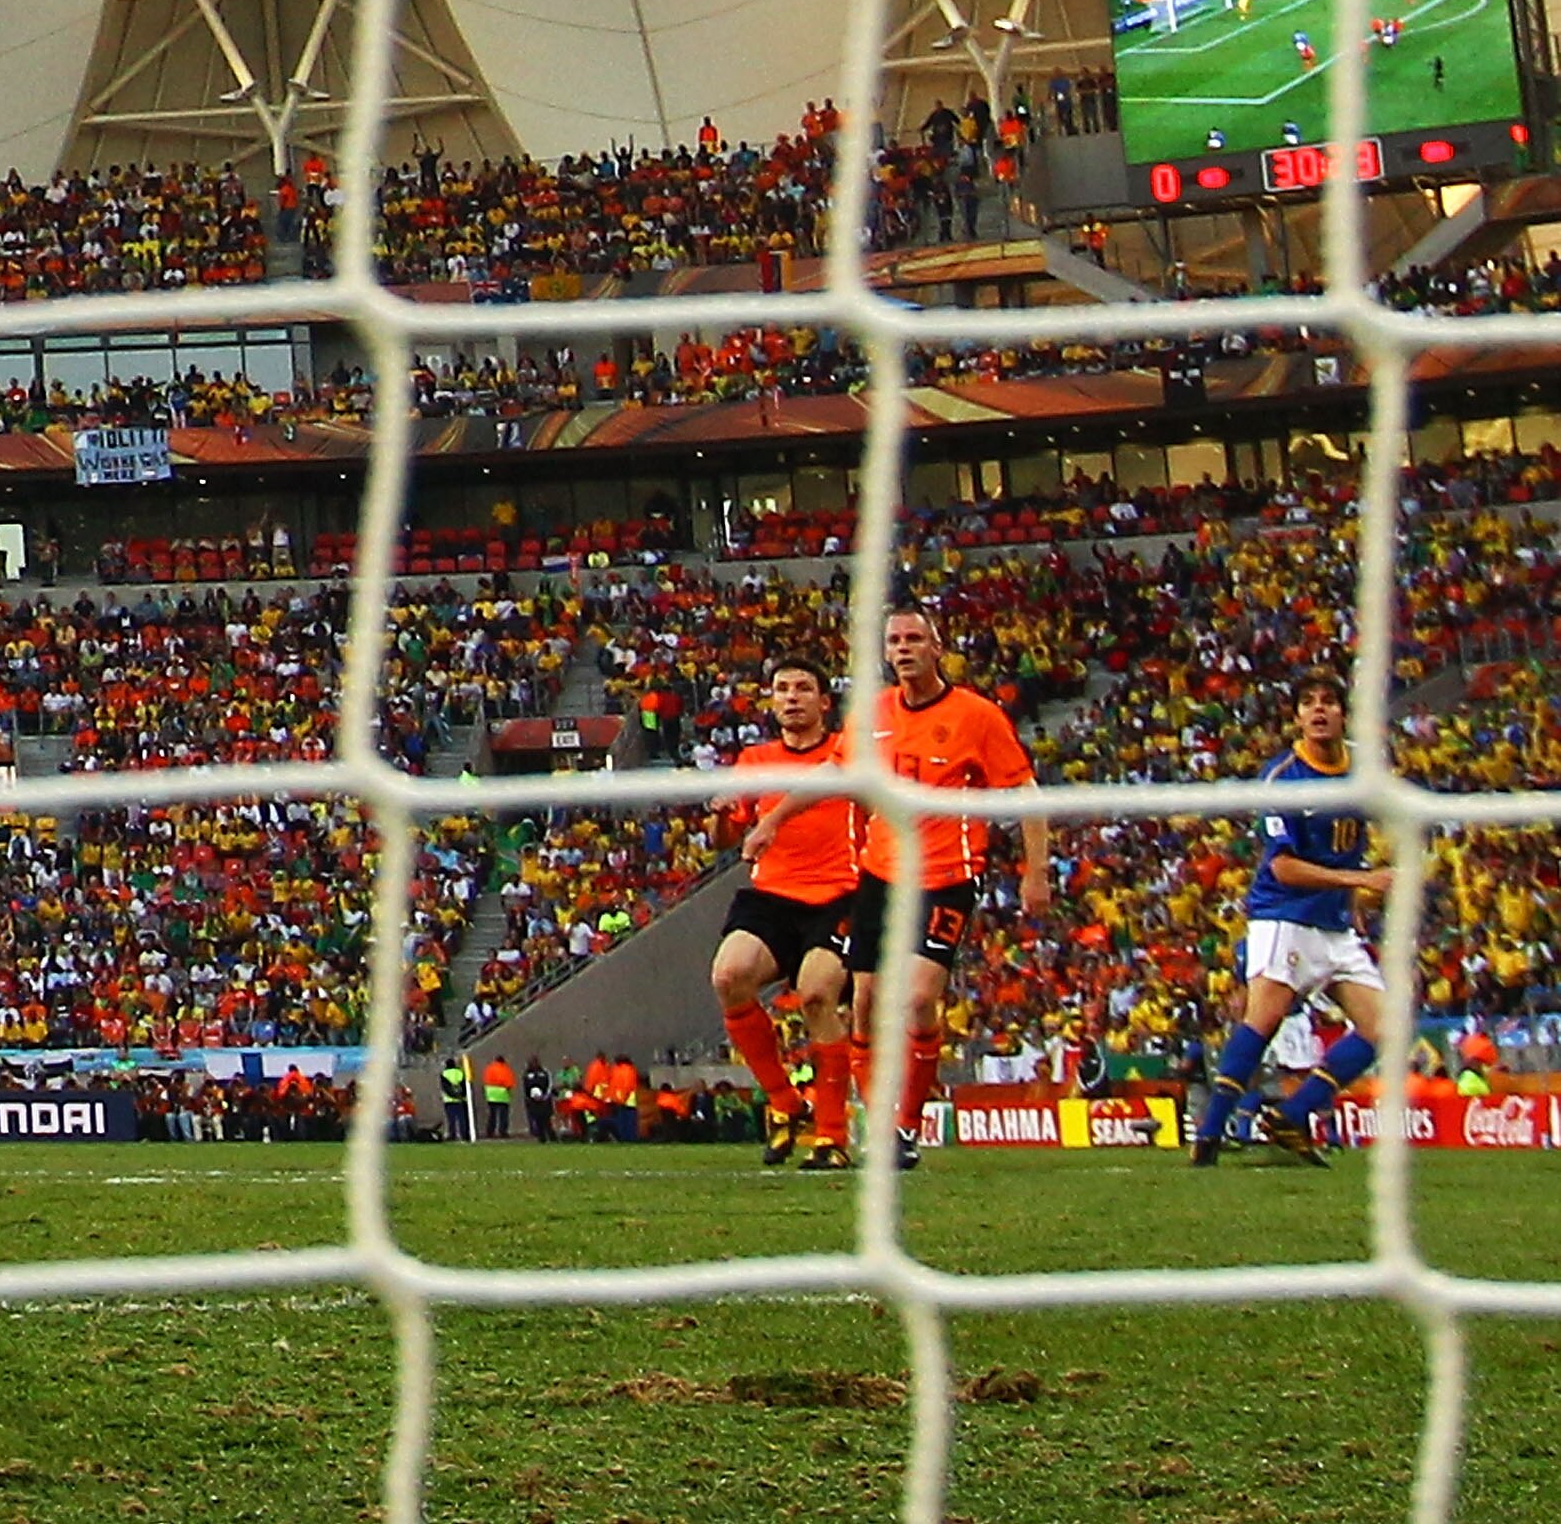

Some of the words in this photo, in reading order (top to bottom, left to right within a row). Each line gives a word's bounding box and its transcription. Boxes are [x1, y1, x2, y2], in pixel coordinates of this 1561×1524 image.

[1331, 817, 1359, 854] 10
[928, 905, 967, 944] 13
[957, 1107, 1058, 1142] BRAHMA
